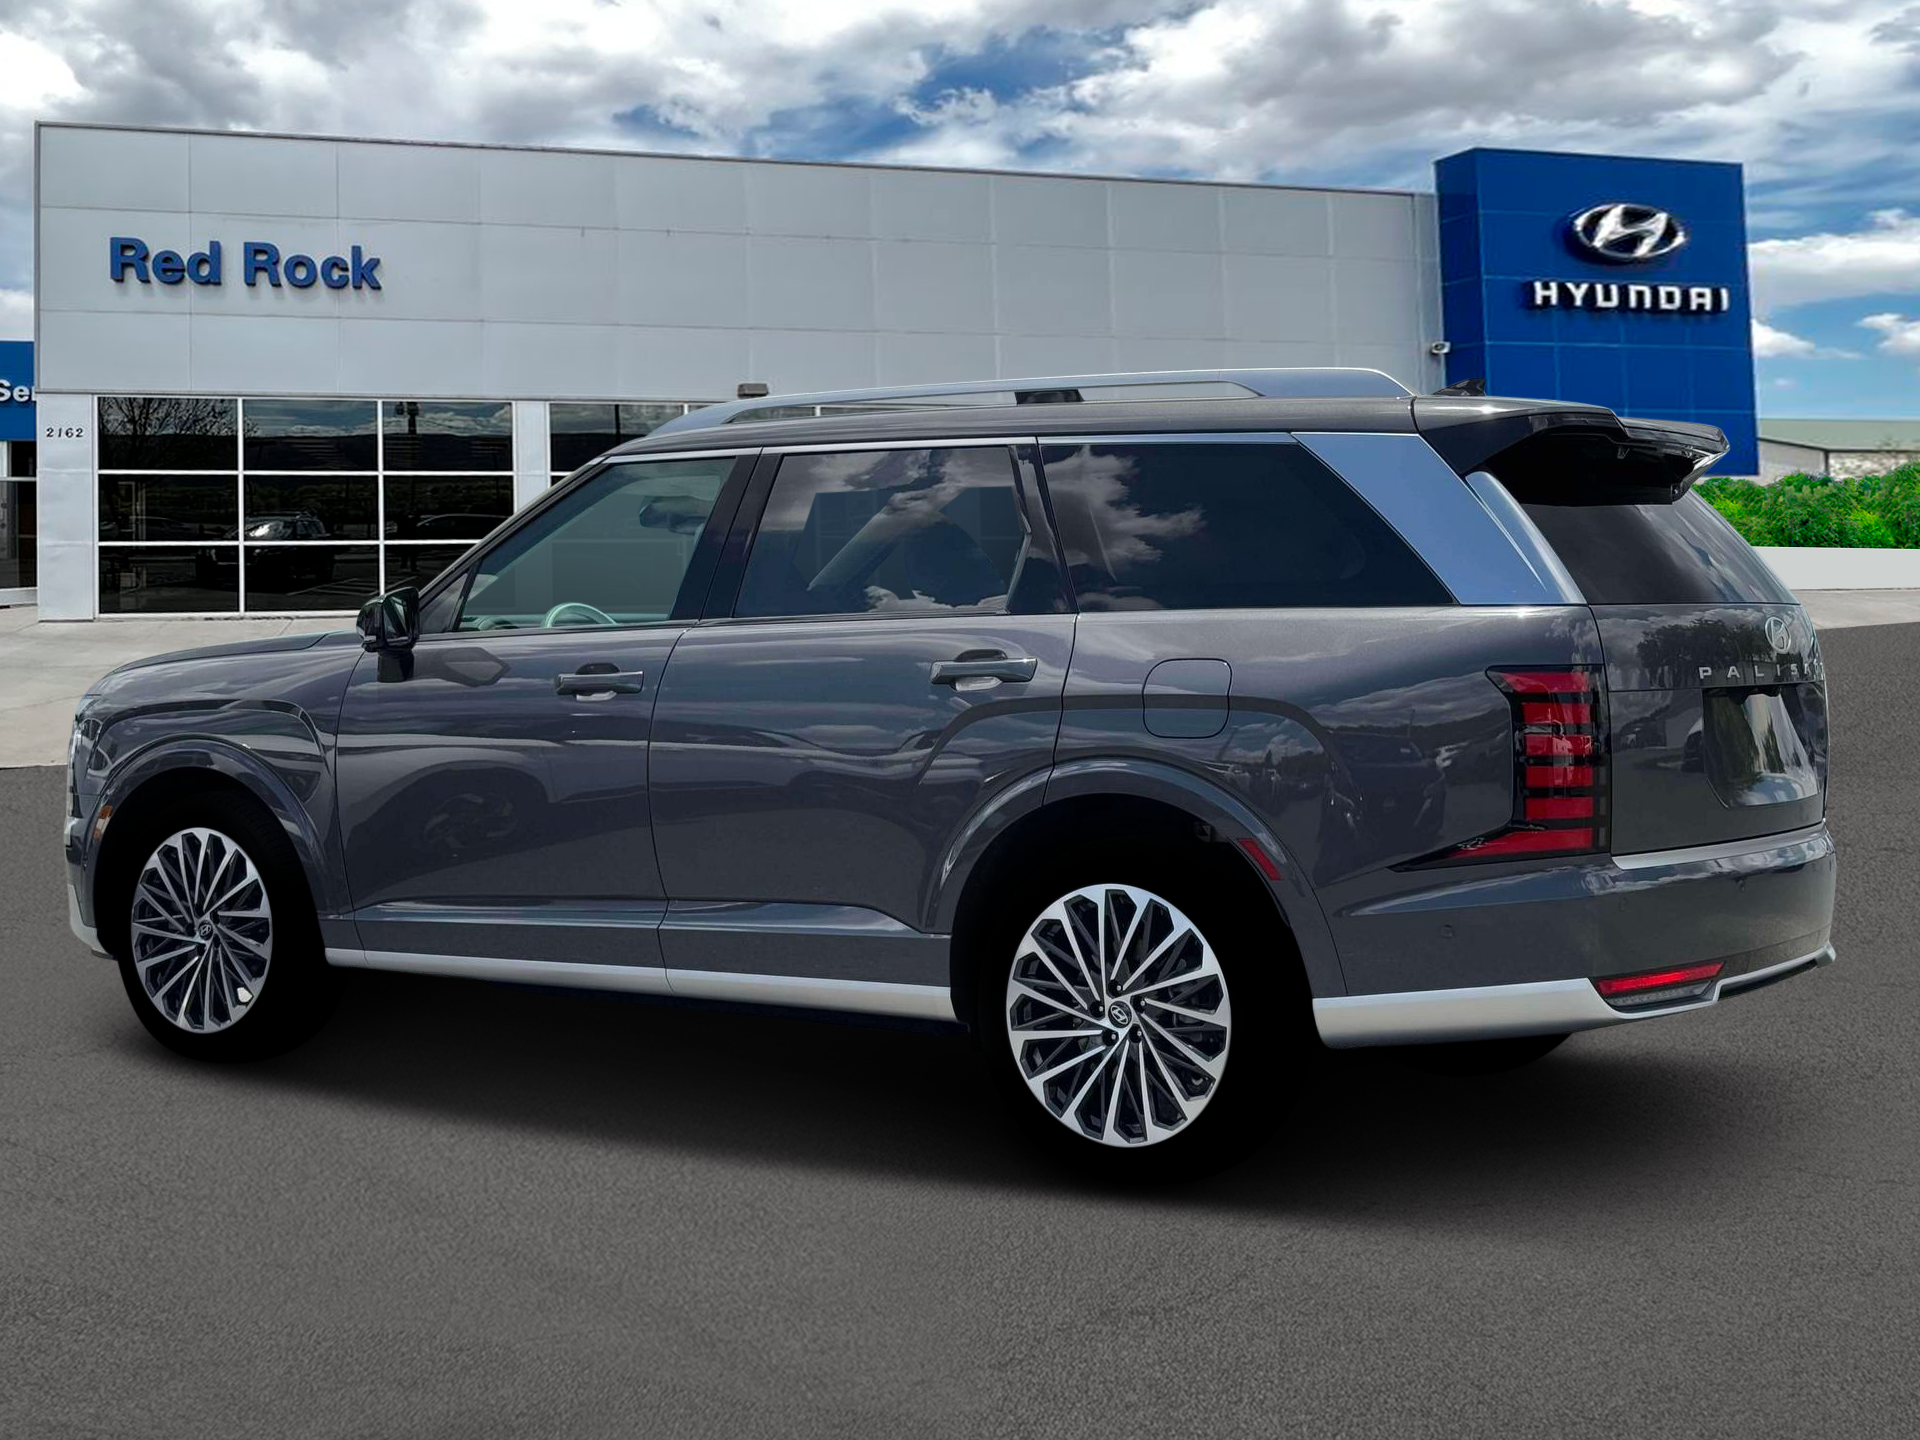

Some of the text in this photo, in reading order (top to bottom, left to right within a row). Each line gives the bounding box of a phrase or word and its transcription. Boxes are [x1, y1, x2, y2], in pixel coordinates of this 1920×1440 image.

[109, 236, 382, 290] Red Rock
[1532, 280, 1730, 312] HYUNDAI
[46, 427, 83, 438] 2162
